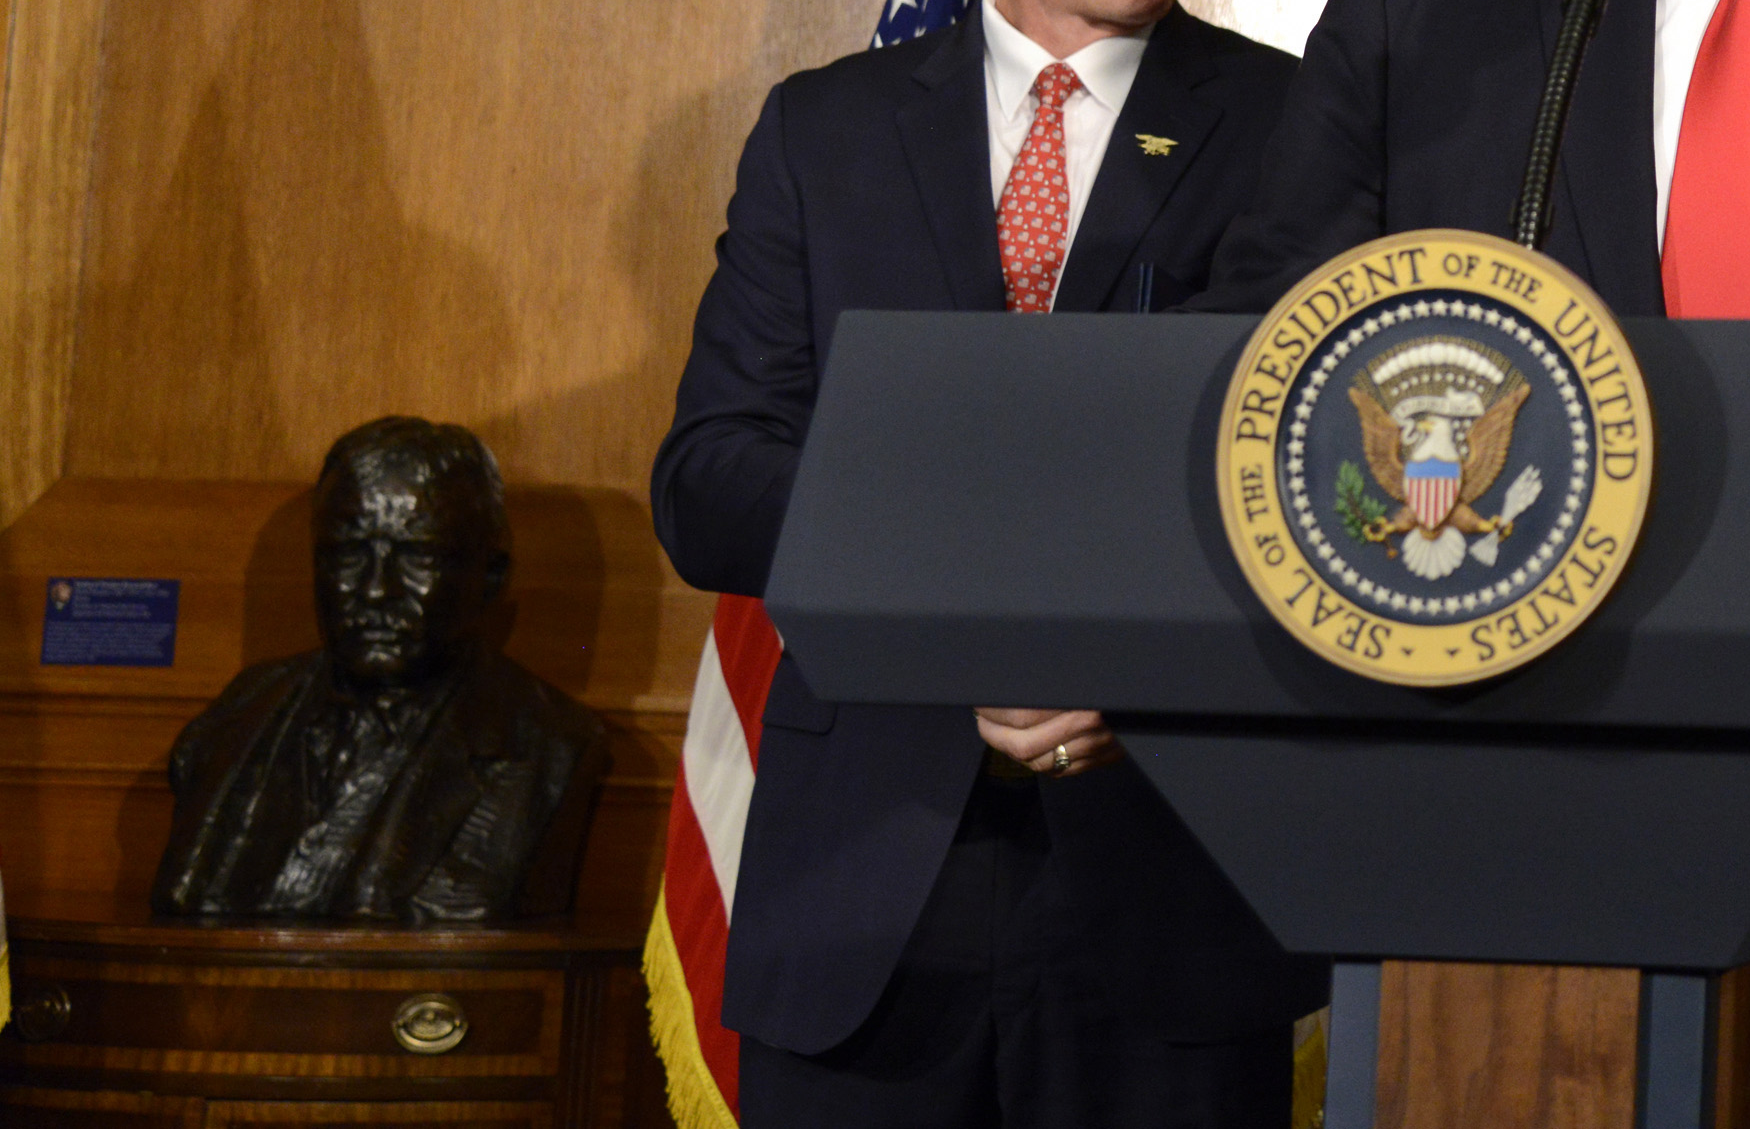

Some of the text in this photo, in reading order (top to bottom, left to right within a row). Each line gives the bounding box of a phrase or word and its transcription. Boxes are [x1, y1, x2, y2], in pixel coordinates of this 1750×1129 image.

[1236, 248, 1638, 662] SEAL OF THE PRESIDENT OF THE UNITED STATES
